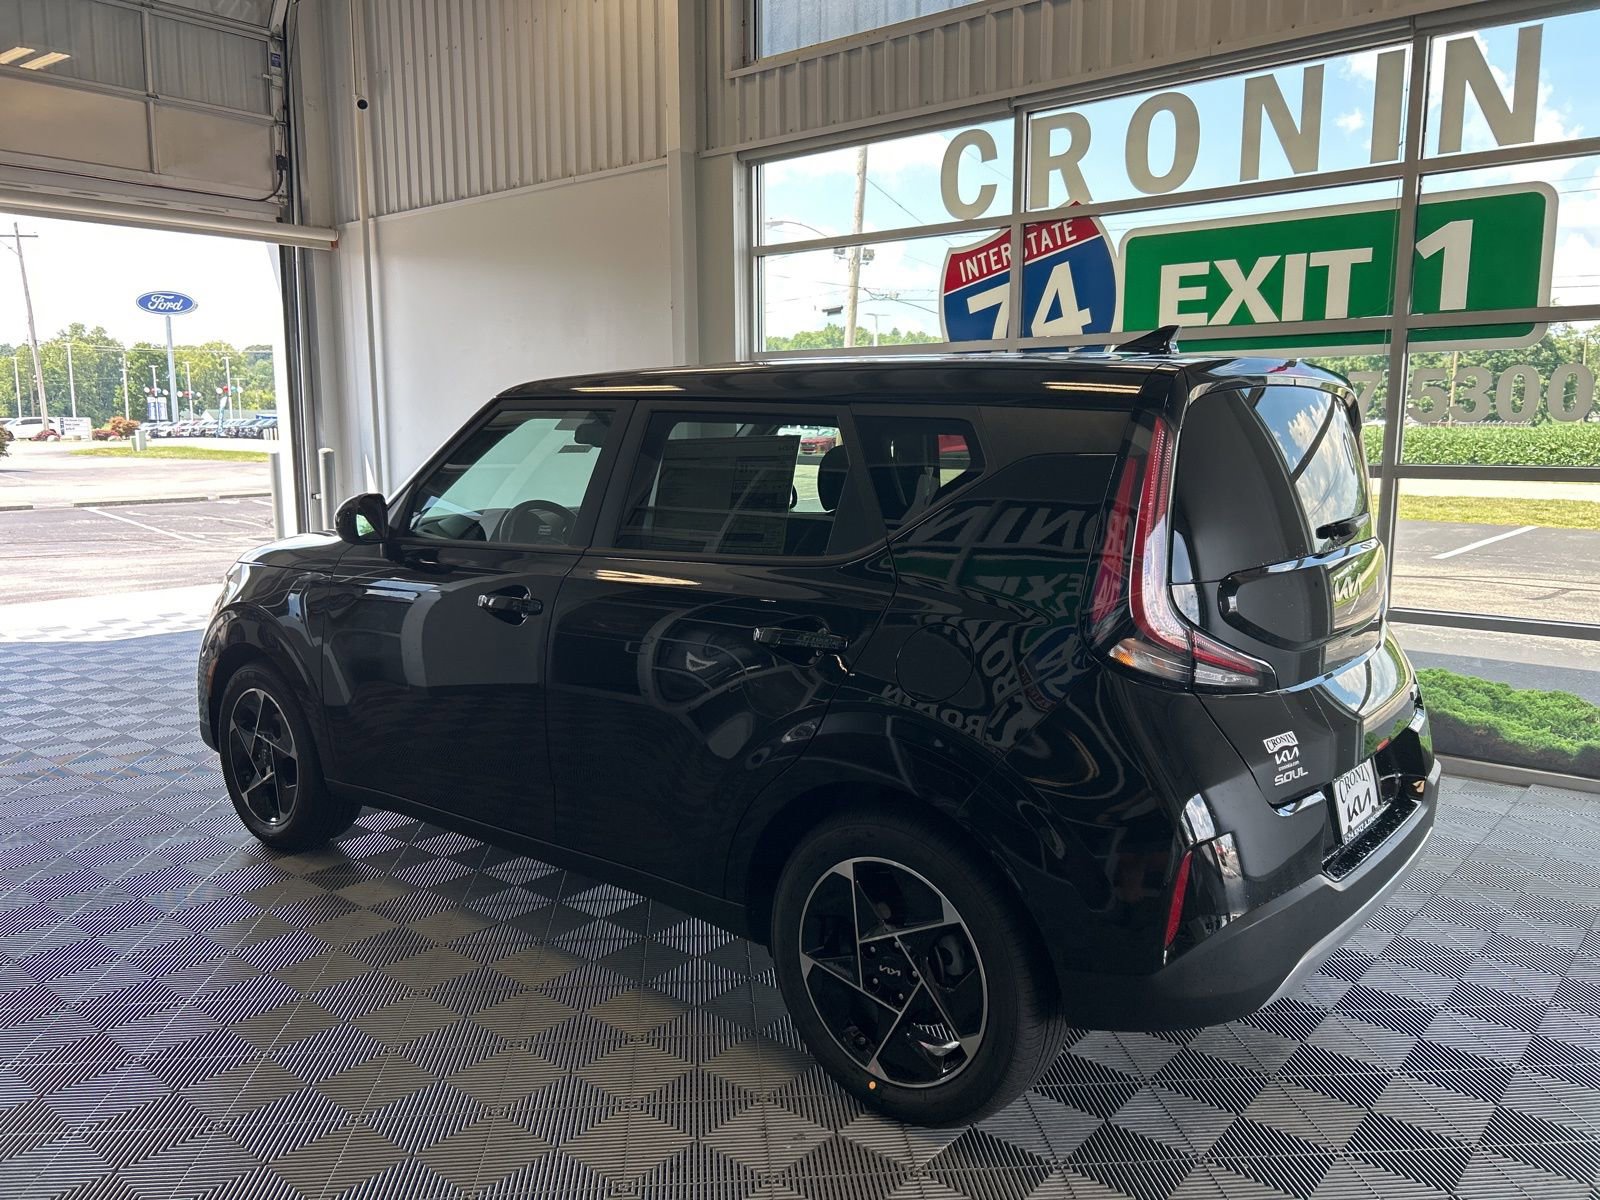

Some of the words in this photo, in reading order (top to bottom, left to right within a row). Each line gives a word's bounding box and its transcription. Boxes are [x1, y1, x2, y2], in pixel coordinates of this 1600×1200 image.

[940, 24, 1543, 220] CRONIN
[959, 219, 1077, 283] INTERTATE
[1158, 247, 1373, 328] EXIT
[1415, 219, 1474, 311] 1
[147, 294, 184, 311] Ford
[966, 261, 1092, 341] 74
[1266, 733, 1297, 752] CRONIN
[1274, 746, 1299, 765] KIA
[1274, 766, 1309, 786] SOUL
[1339, 763, 1371, 804] CRONIN
[1347, 787, 1371, 823] KIA
